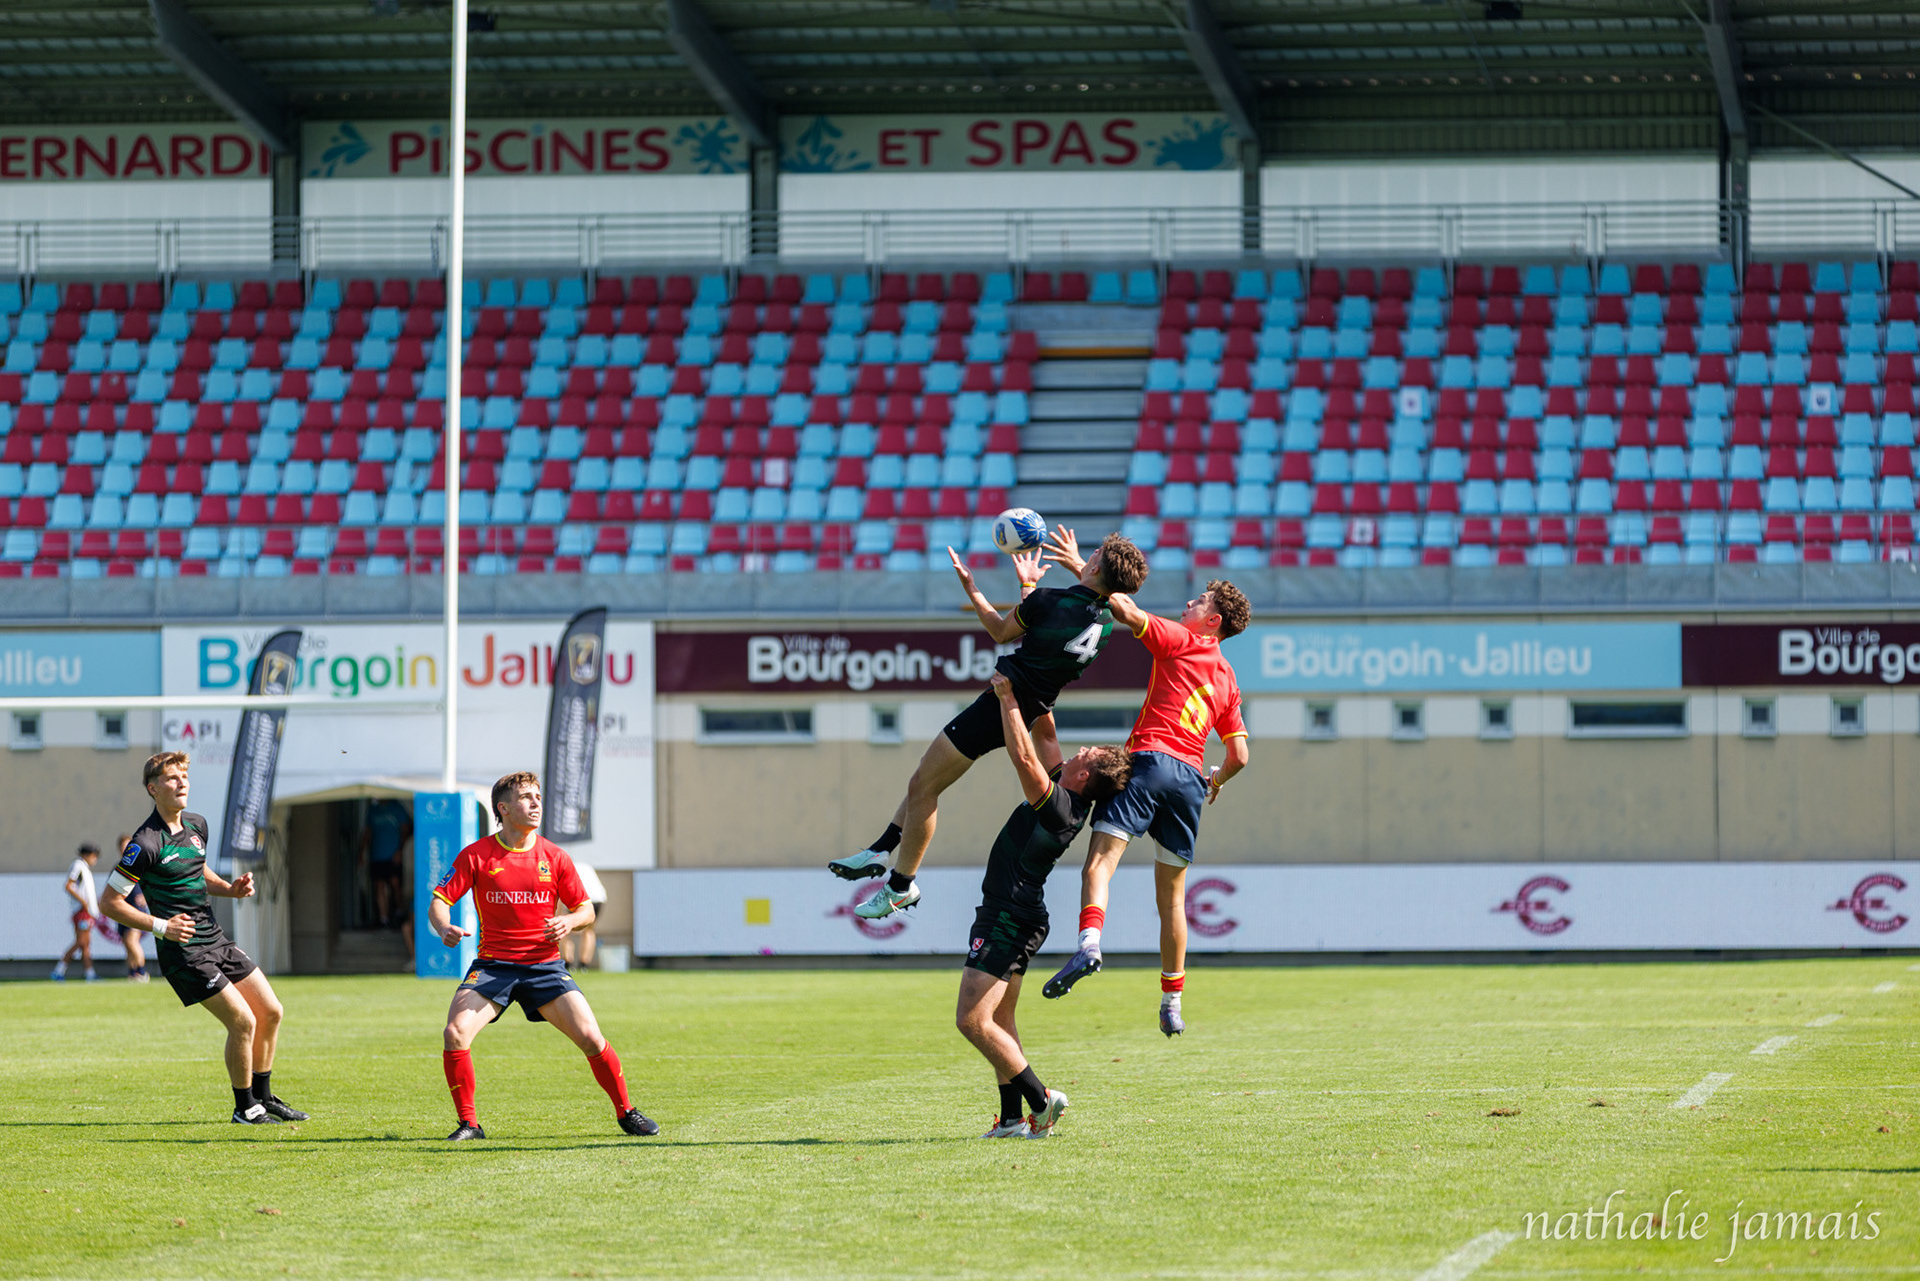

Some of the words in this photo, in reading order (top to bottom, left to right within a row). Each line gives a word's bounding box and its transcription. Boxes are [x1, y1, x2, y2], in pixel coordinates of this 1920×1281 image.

[878, 130, 941, 167] ET
[966, 118, 1140, 168] SPAS
[1063, 623, 1103, 664] 4
[1814, 626, 1853, 645] Ville
[1856, 626, 1880, 645] de
[0, 649, 82, 686] llieu
[199, 636, 437, 696] Brgoin
[463, 633, 634, 687] Jallu
[1180, 683, 1214, 735] 6
[163, 719, 221, 741] CAPI
